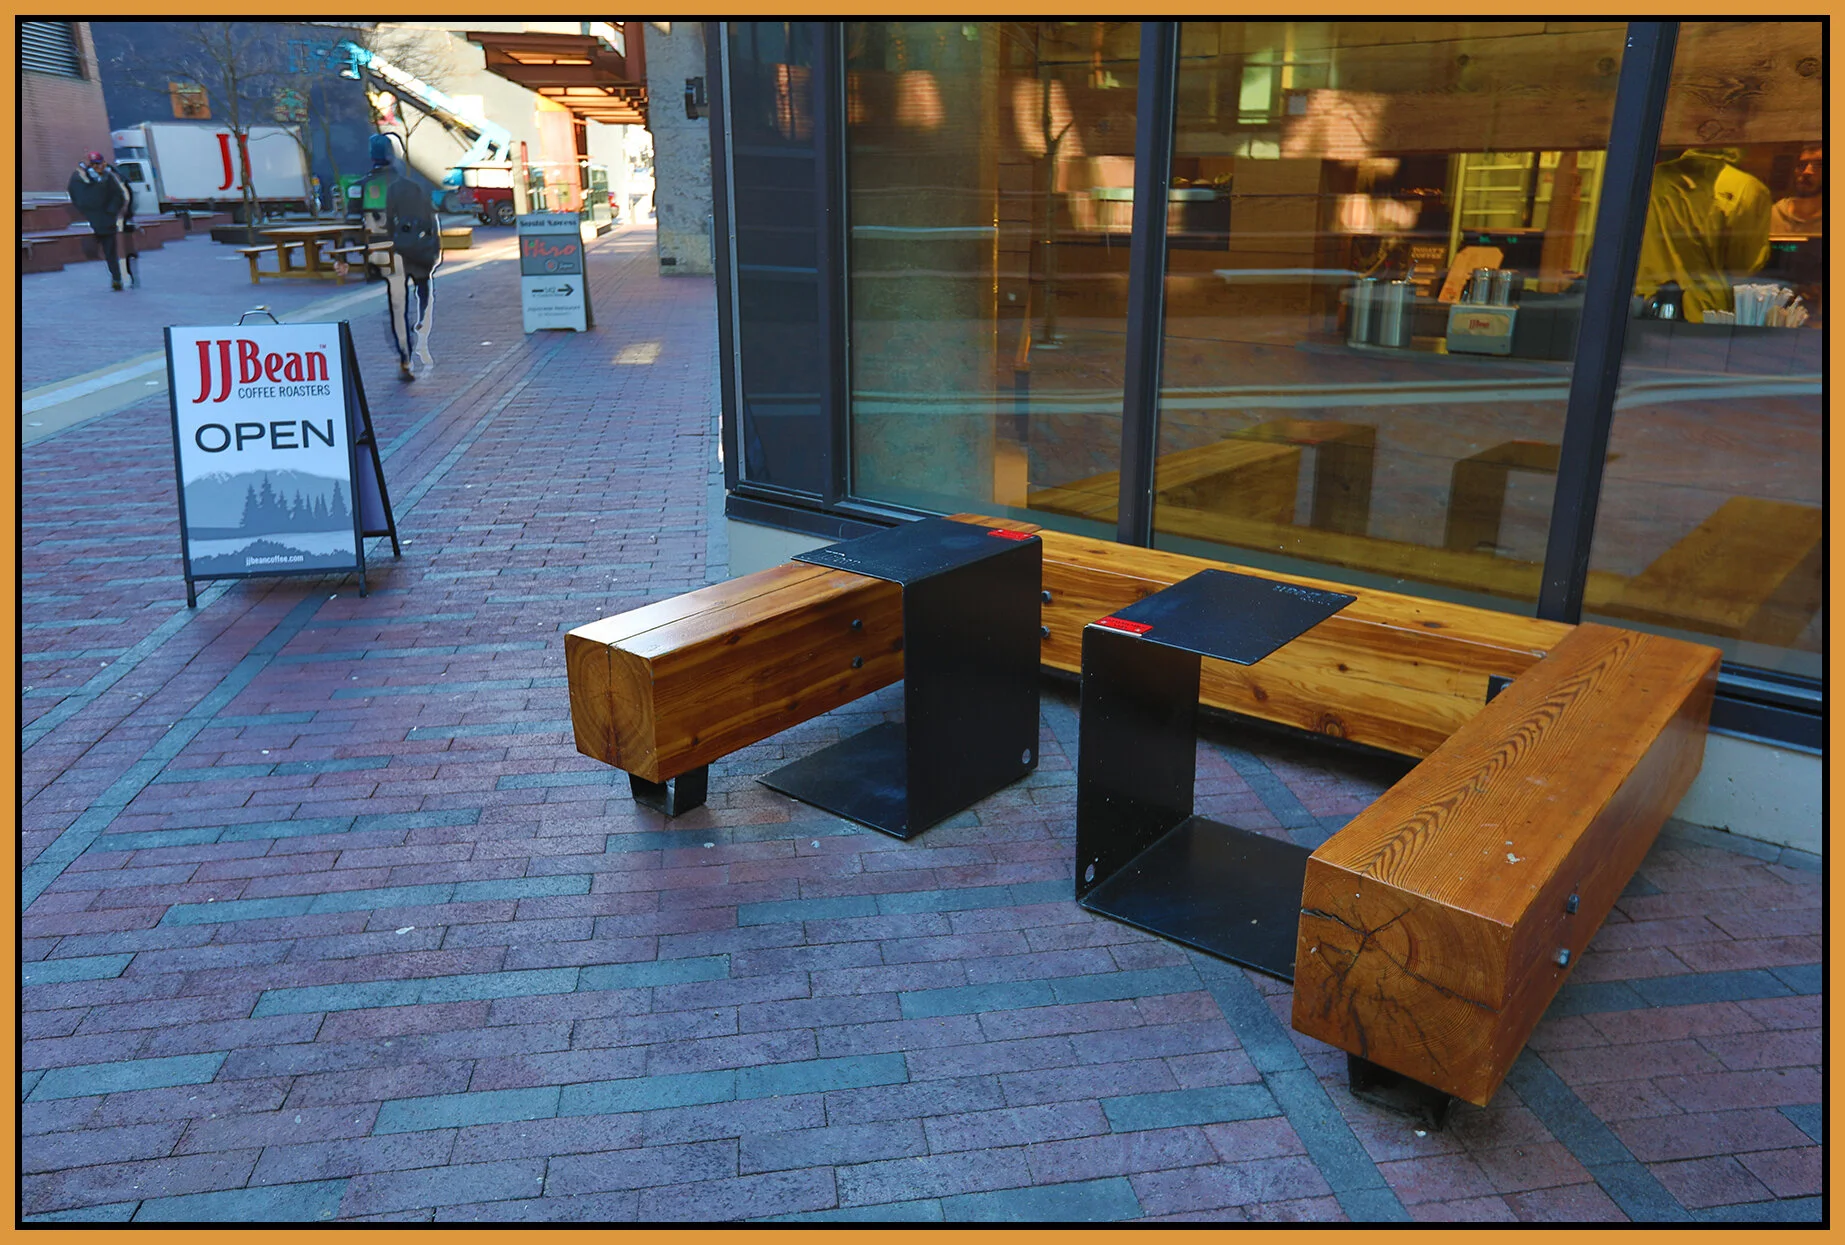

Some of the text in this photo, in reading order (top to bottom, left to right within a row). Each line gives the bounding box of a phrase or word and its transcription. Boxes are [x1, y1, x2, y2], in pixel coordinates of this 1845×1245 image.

[523, 238, 577, 258] Hiro
[238, 384, 331, 399] COFFEE ROASTERS
[195, 418, 335, 453] OPEN
[245, 554, 304, 567] jjbeancoffee.com
